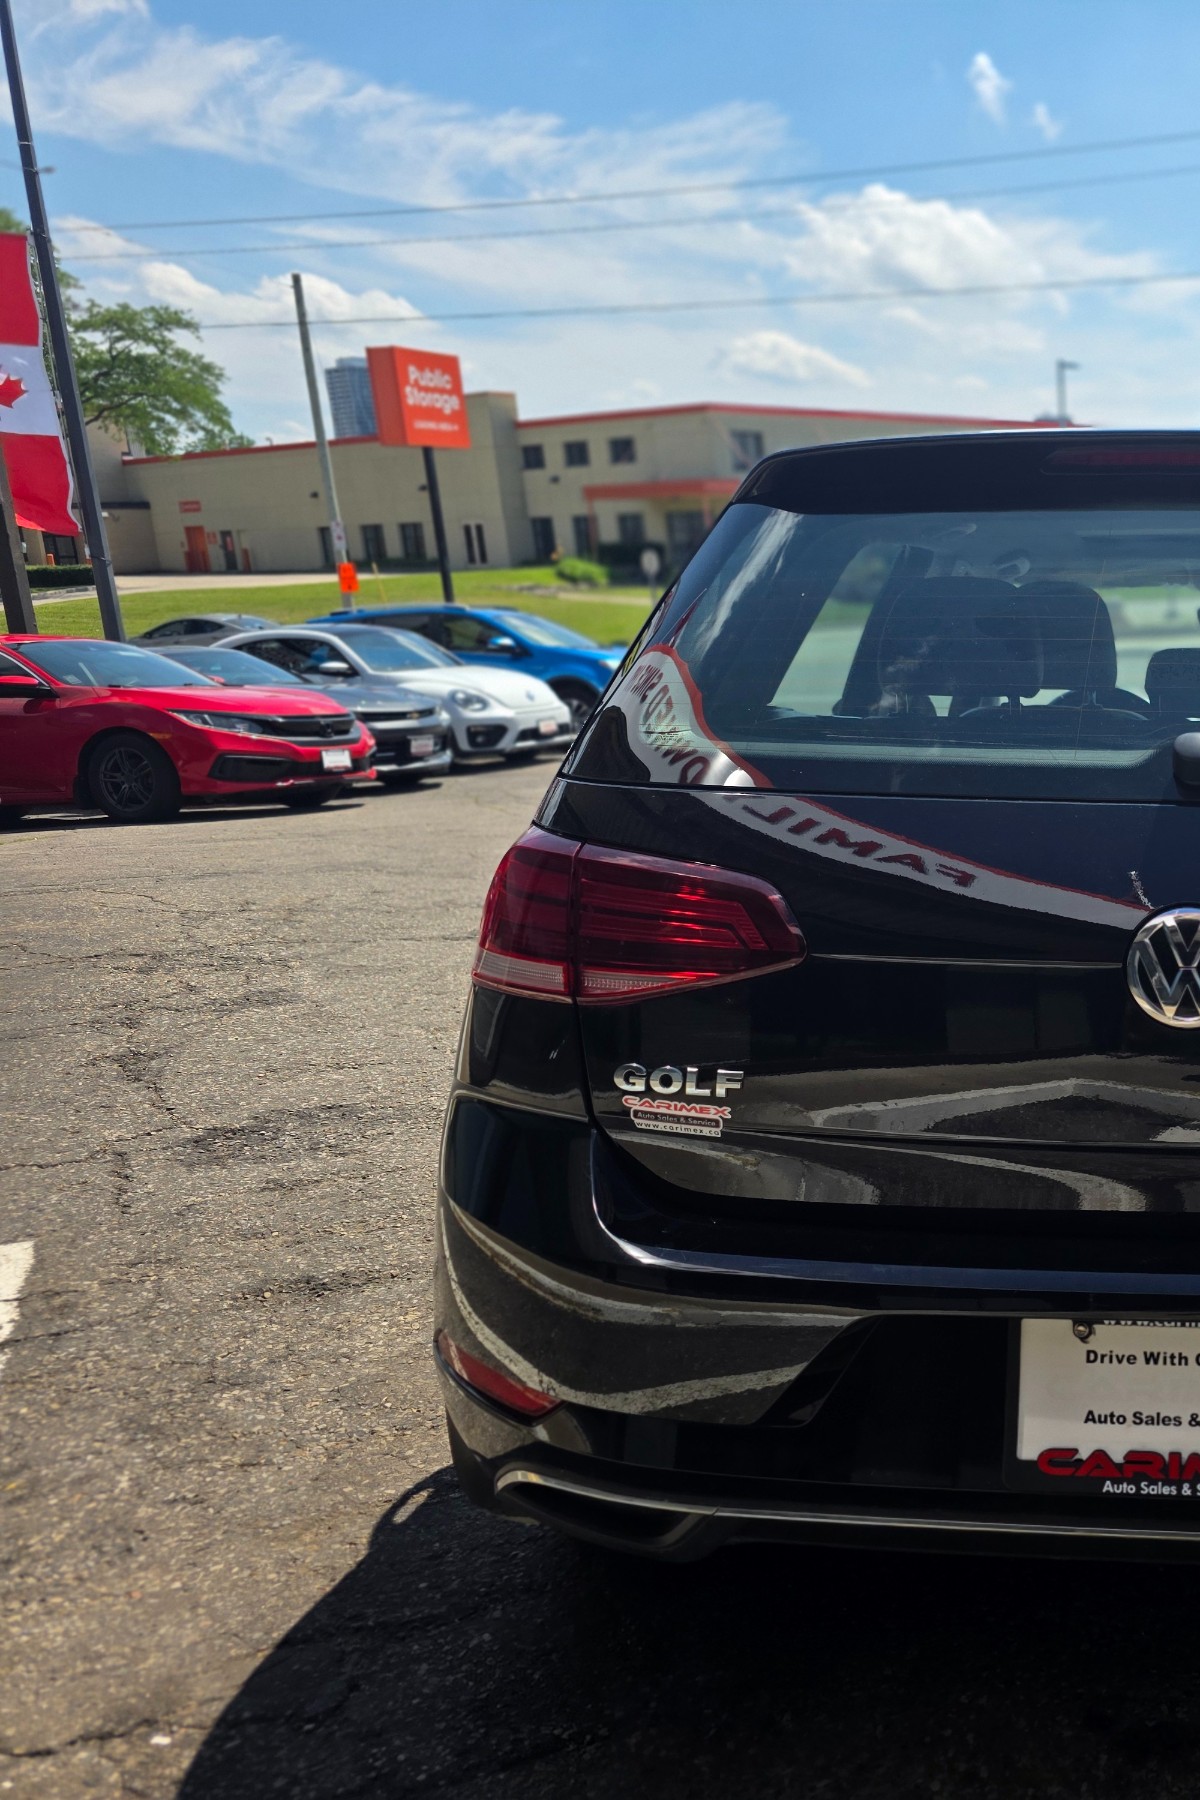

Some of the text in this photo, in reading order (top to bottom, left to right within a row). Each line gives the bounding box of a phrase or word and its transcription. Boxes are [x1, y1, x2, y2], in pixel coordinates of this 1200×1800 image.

[407, 365, 452, 390] Public
[405, 385, 461, 415] Storage
[613, 1063, 745, 1098] GOLF
[623, 1097, 731, 1118] CARIMEX
[637, 1111, 656, 1120] Auto
[658, 1114, 678, 1123] Sales
[687, 1118, 716, 1127] Service
[635, 1121, 720, 1136] www.carimex.ca
[1085, 1350, 1137, 1365] Drive
[1143, 1351, 1189, 1367] With
[1084, 1410, 1127, 1425] Auto
[1132, 1411, 1182, 1427] Sales
[1102, 1480, 1136, 1495] Auto
[1140, 1481, 1177, 1496] Sales
[1181, 1482, 1192, 1496] &
